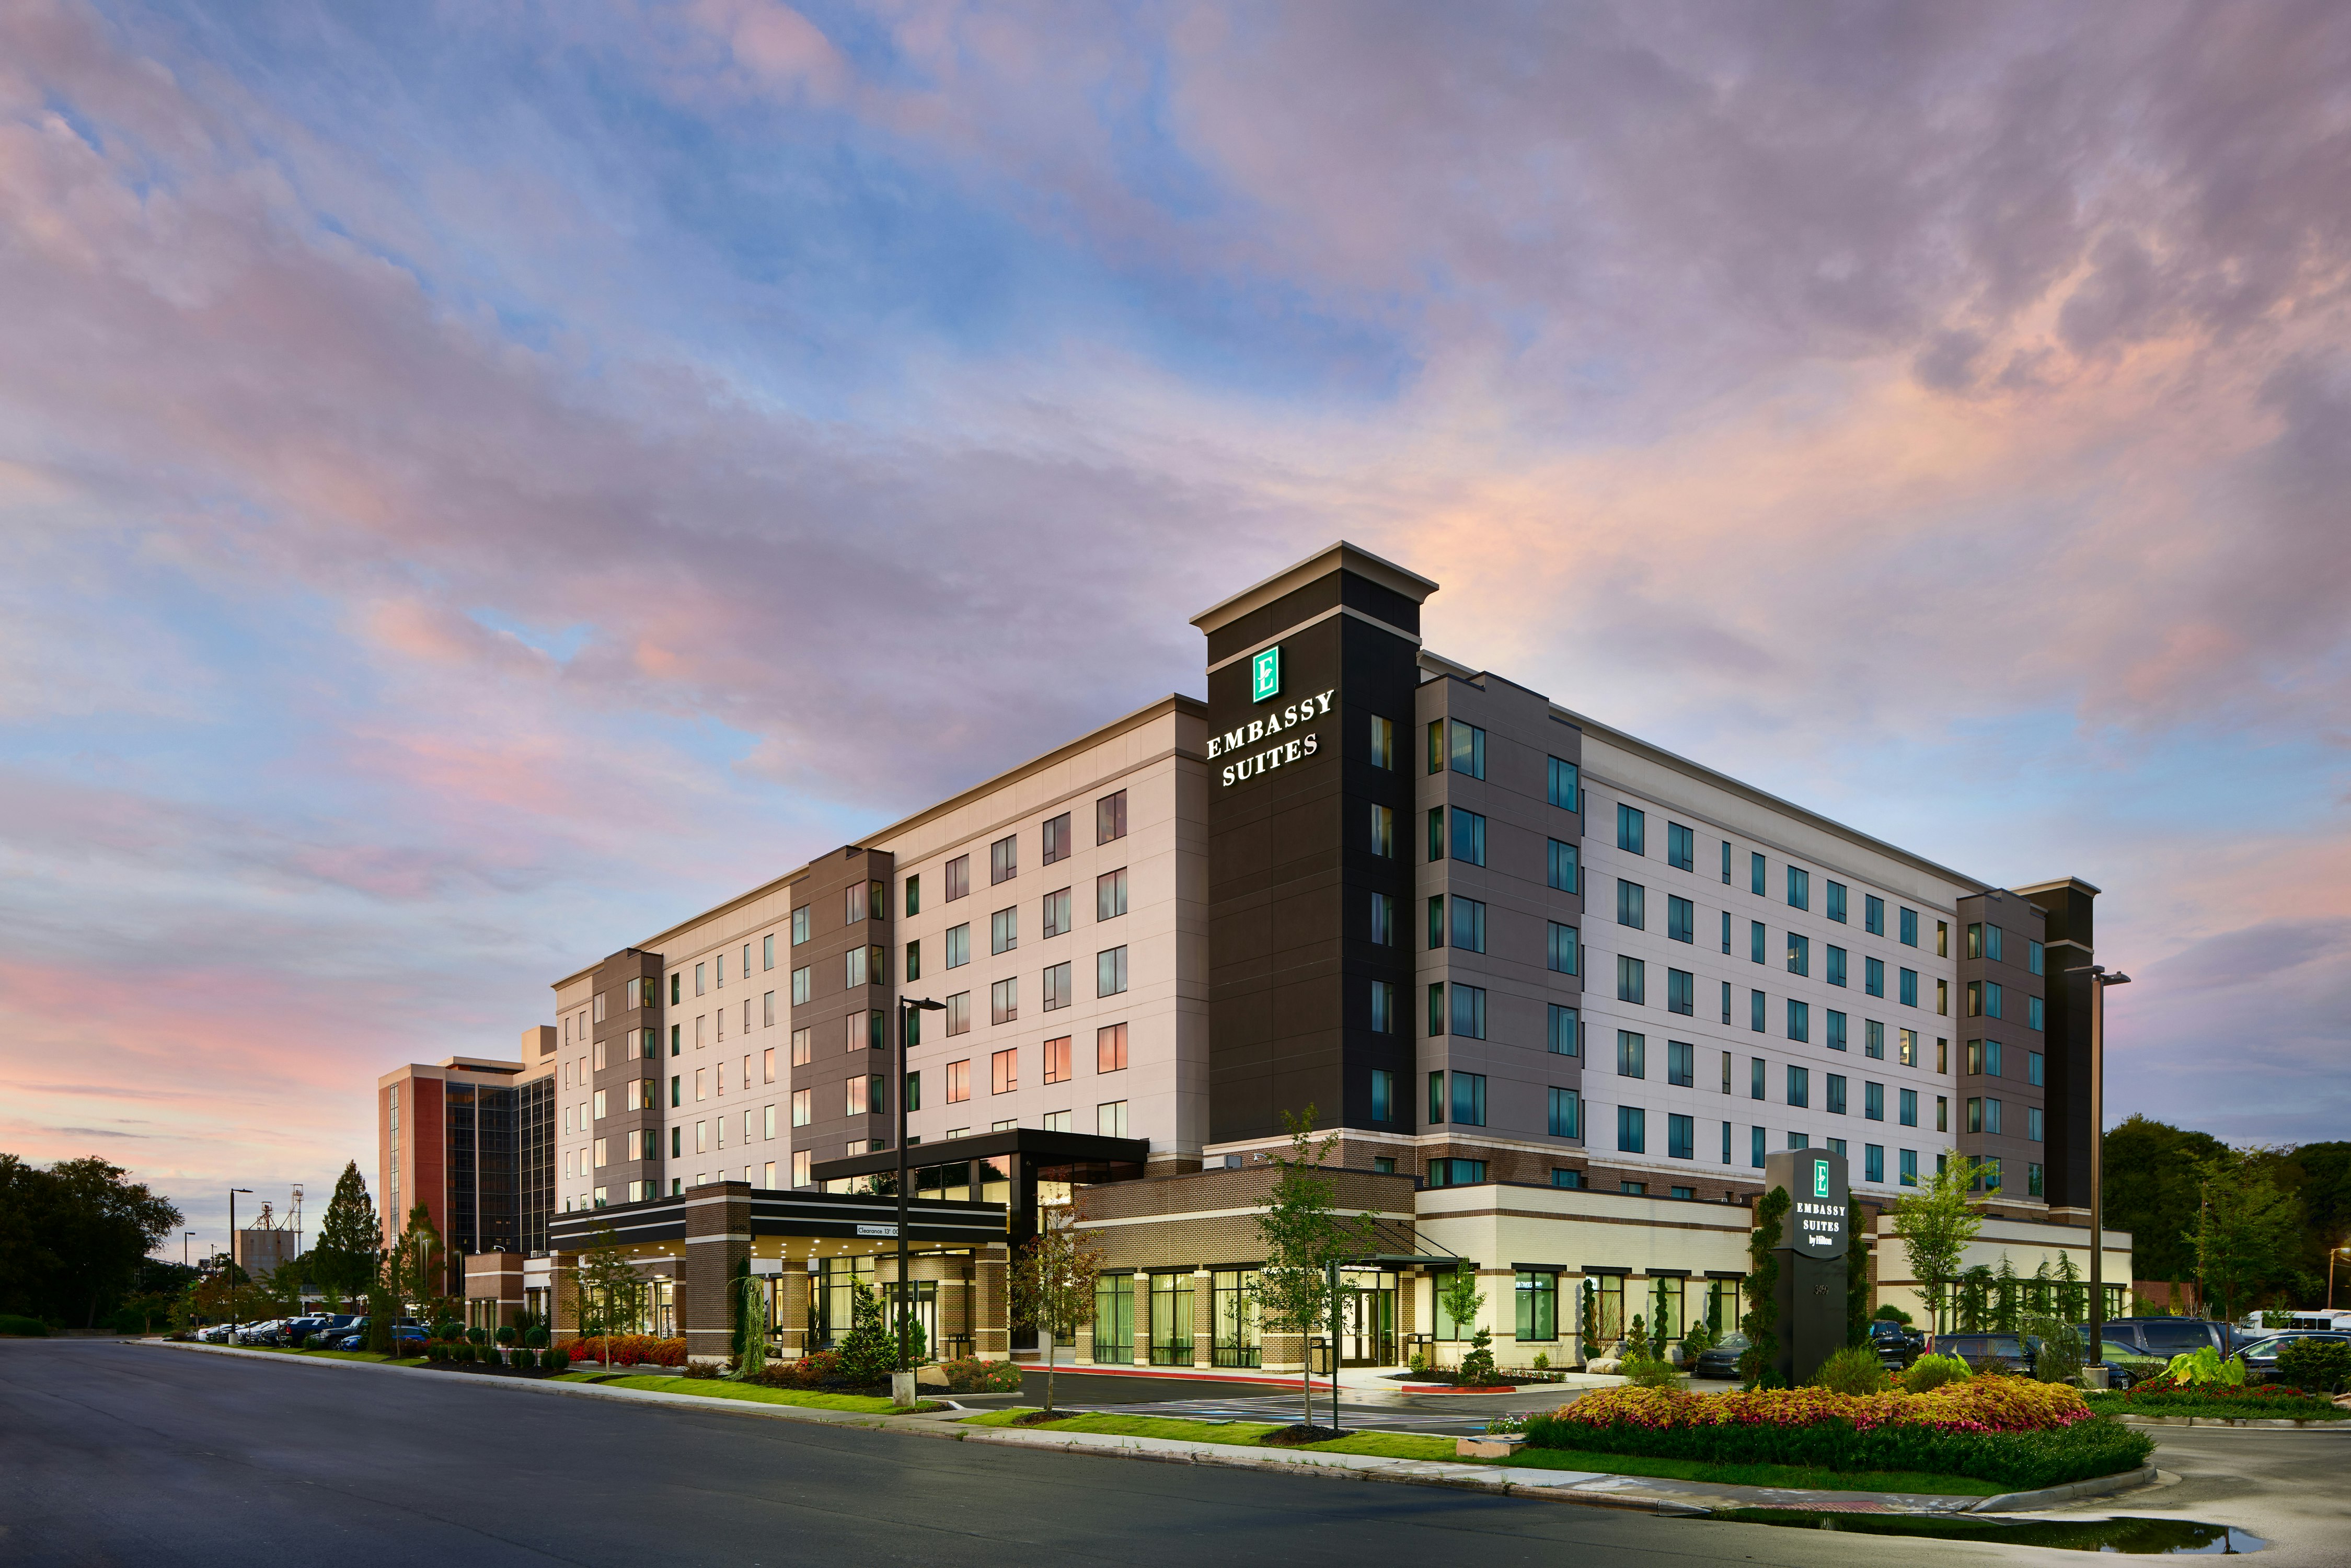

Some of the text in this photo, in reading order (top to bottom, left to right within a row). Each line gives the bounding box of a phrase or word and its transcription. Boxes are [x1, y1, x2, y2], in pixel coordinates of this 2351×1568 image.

[1206, 689, 1334, 760] EMBASSY
[1223, 733, 1318, 787] SUITES
[1796, 1202, 1846, 1216] EMBASSY
[1803, 1219, 1839, 1232] SUITES
[1809, 1235, 1832, 1247] by Hilton
[1815, 1284, 1829, 1295] 3450
